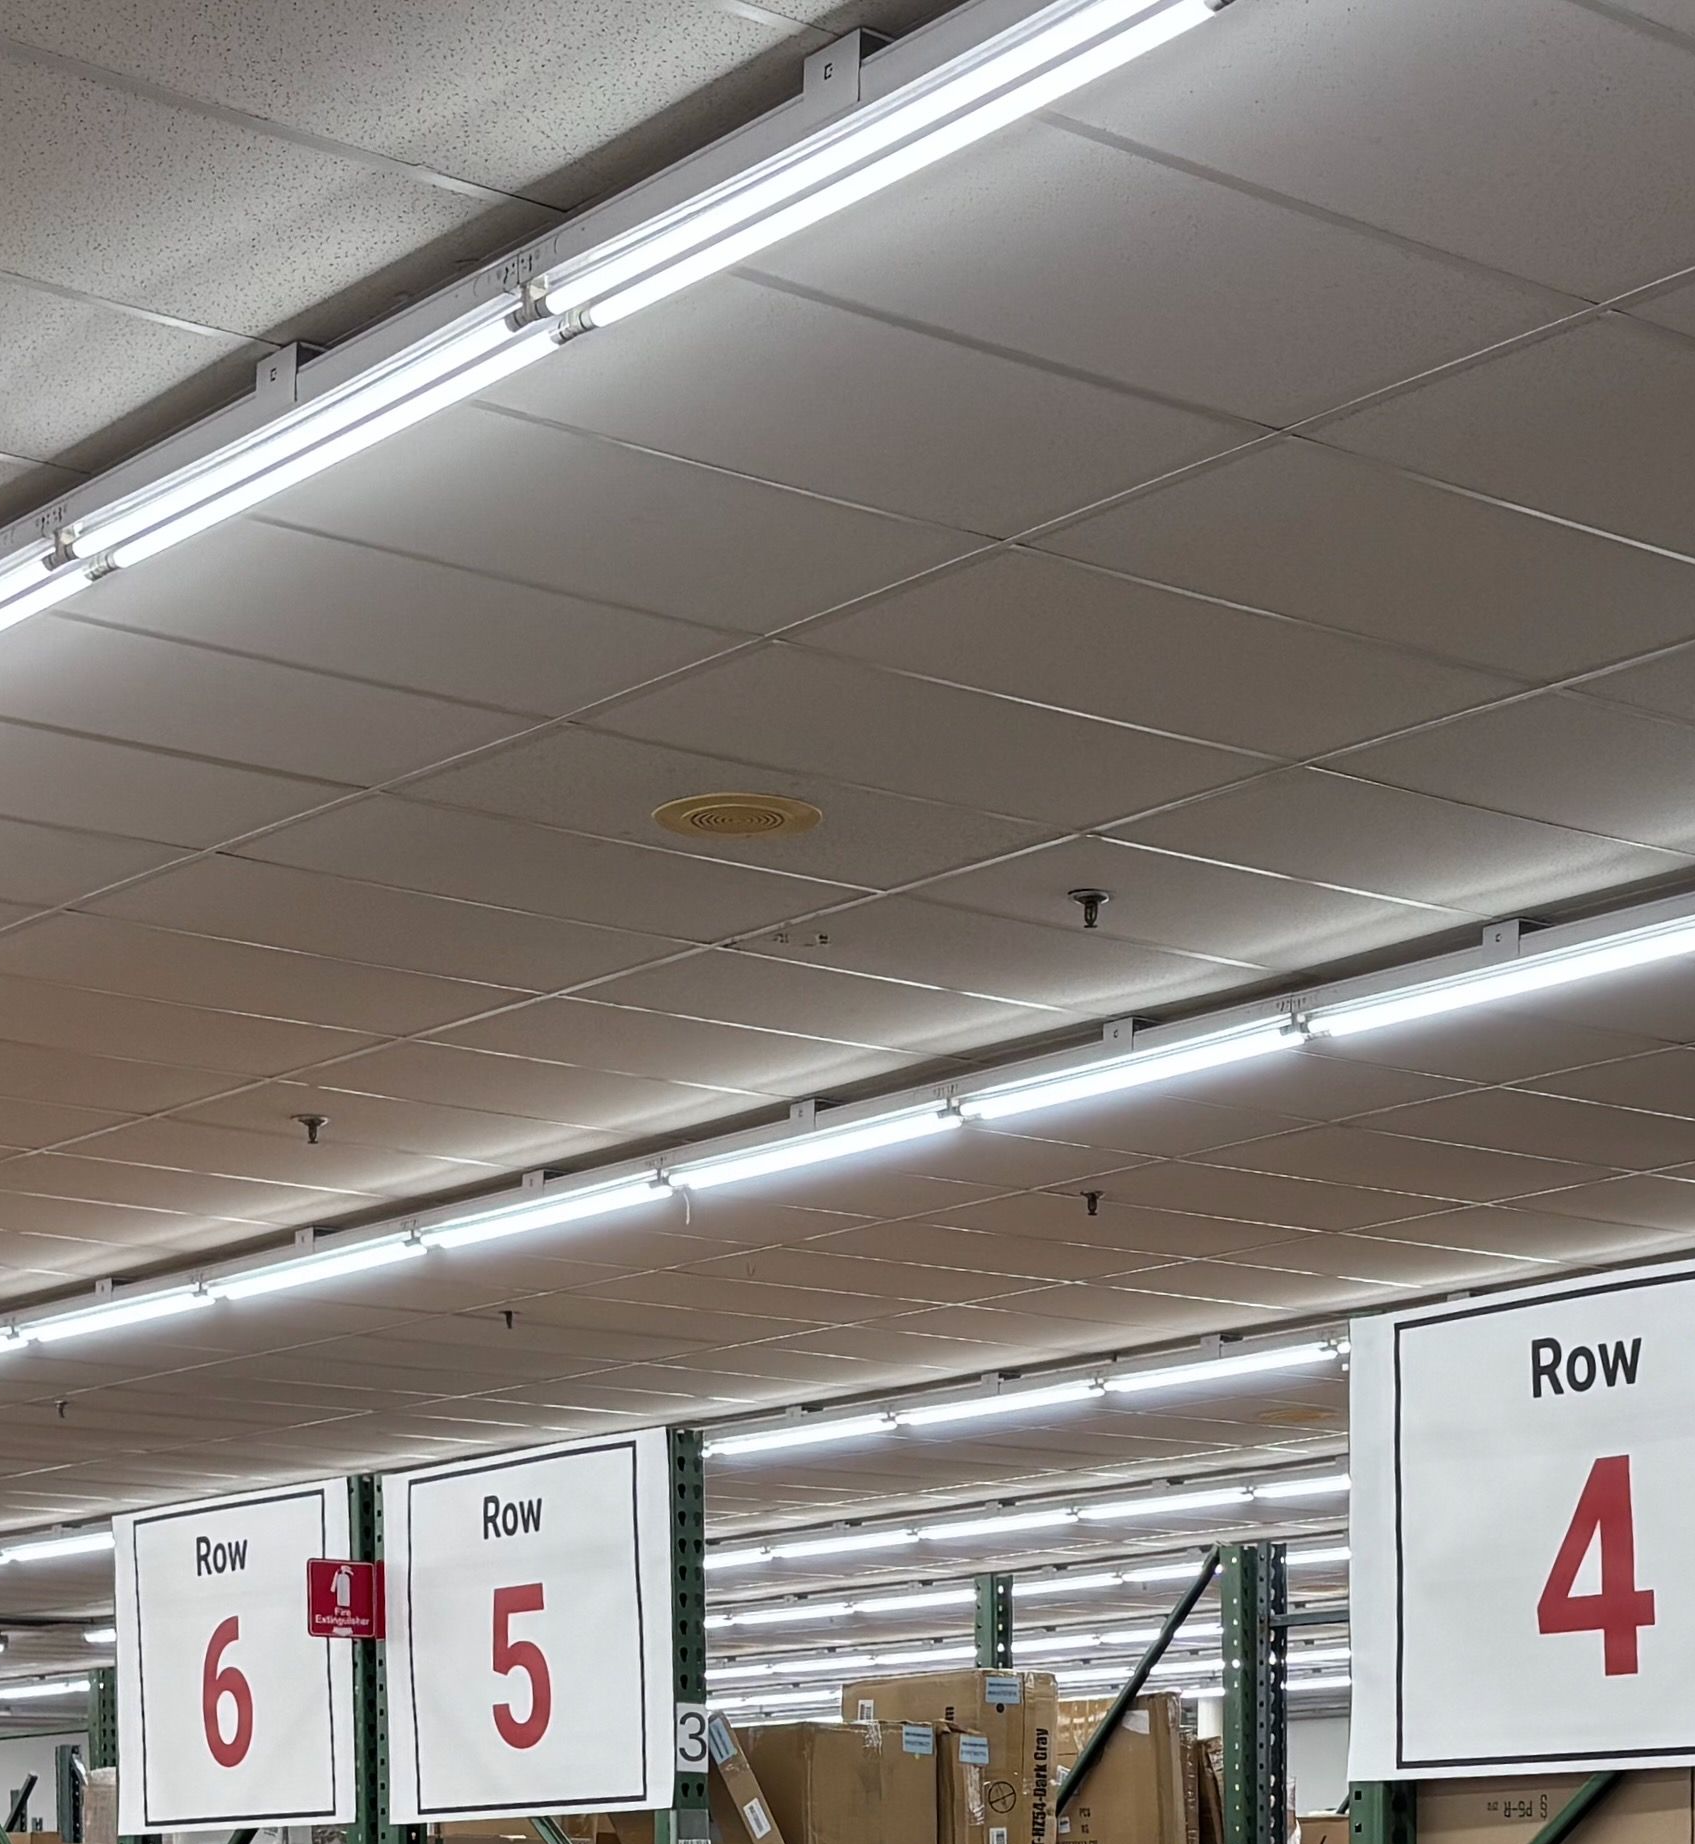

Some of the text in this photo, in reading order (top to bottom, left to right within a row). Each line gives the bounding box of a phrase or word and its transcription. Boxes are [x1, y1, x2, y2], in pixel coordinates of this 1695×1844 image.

[1530, 1336, 1643, 1398] Row
[483, 1495, 542, 1540] Row
[196, 1535, 247, 1576] Row
[1537, 1454, 1657, 1677] 4
[315, 1614, 369, 1627] Extinguisher
[335, 1608, 351, 1617] Fire
[493, 1582, 552, 1750] 5
[203, 1615, 253, 1767] 6
[678, 1711, 706, 1761] 3
[1034, 1728, 1049, 1761] Gray
